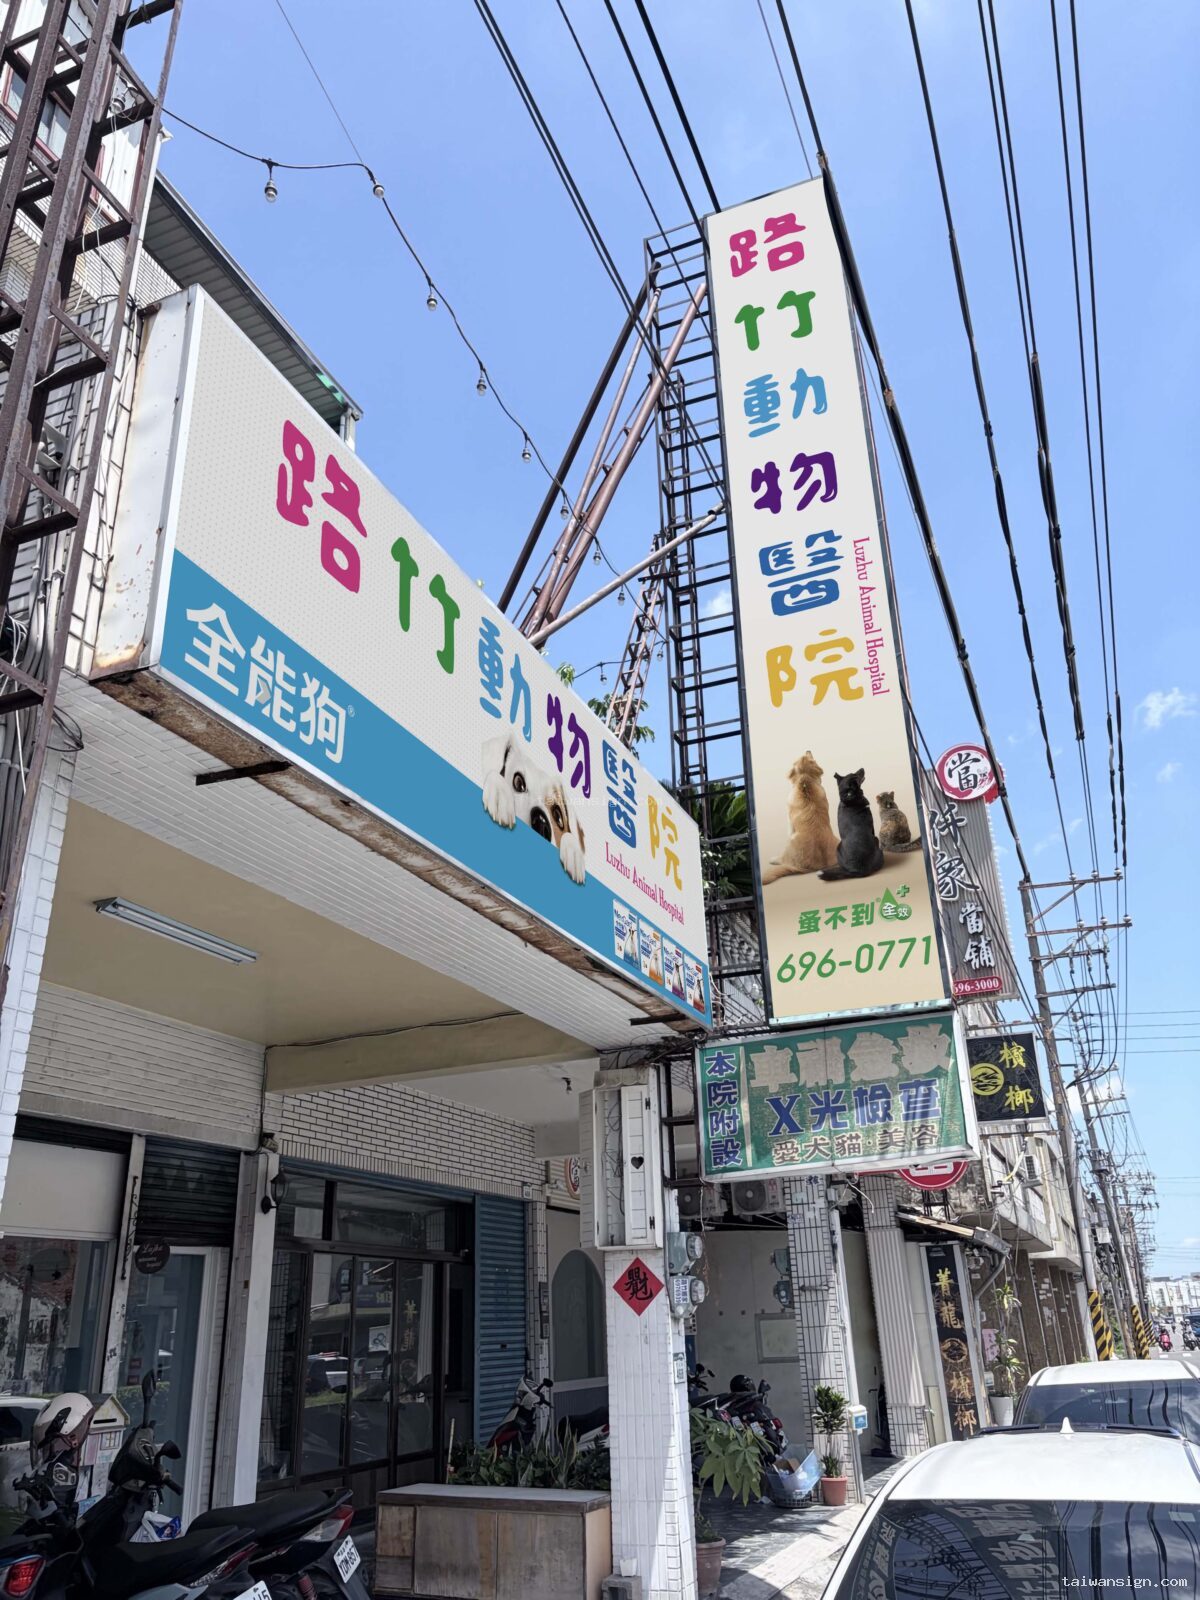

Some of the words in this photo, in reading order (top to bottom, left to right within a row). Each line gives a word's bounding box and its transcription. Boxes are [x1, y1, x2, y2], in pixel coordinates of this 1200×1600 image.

[729, 212, 865, 708] 路竹動物醫院
[853, 537, 873, 581] Luzhu
[859, 585, 882, 635] Animal
[184, 603, 347, 764] 全能狗
[276, 420, 683, 891] 路竹動物醫院
[864, 637, 890, 696] Hospital
[605, 842, 631, 880] Luzhu
[632, 865, 658, 903] Animal
[658, 888, 684, 926] Hospital
[798, 901, 875, 935] 蚤不到
[777, 935, 932, 983] 696-0771
[705, 1050, 742, 1168] 本院附設
[766, 1077, 942, 1137] X光檢查
[999, 1041, 1034, 1114] 檳榔
